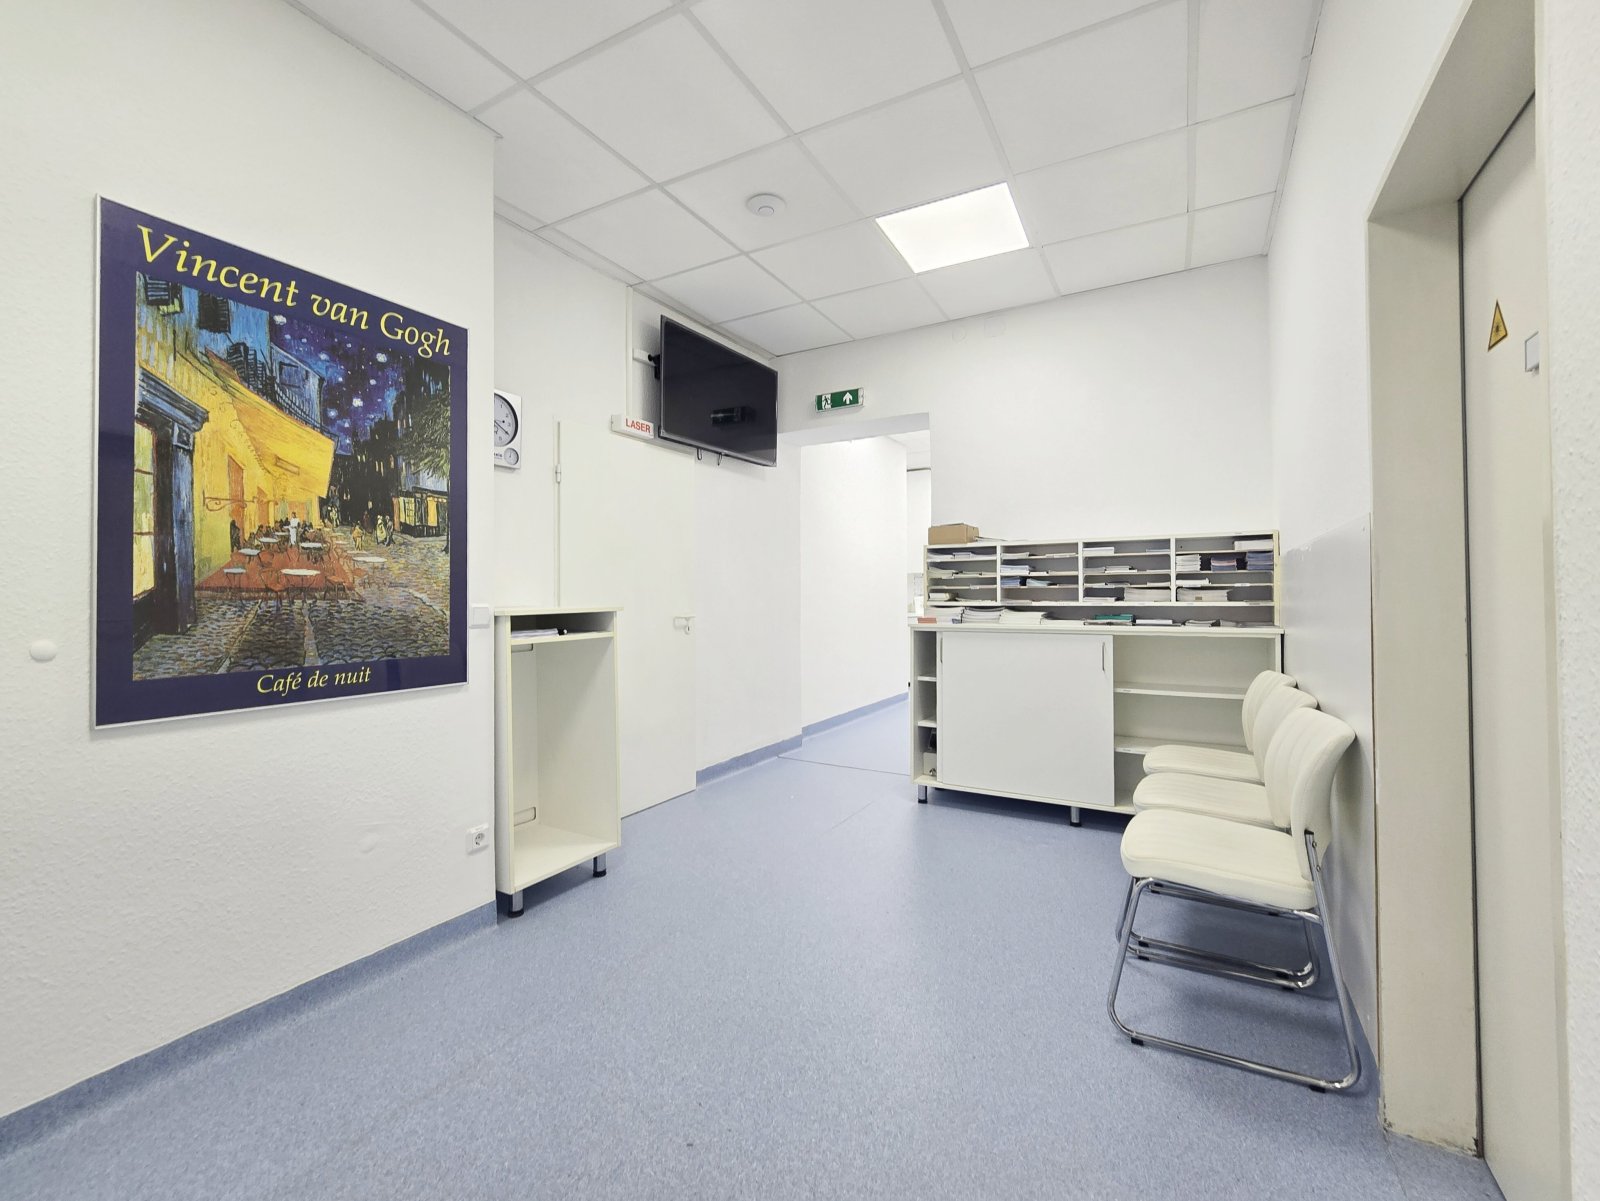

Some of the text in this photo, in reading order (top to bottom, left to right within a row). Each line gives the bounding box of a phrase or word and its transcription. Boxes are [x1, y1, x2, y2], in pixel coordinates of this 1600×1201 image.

[136, 224, 451, 357] Vincent van Gogh
[625, 418, 651, 433] LASER
[257, 666, 371, 697] Café de nuit
